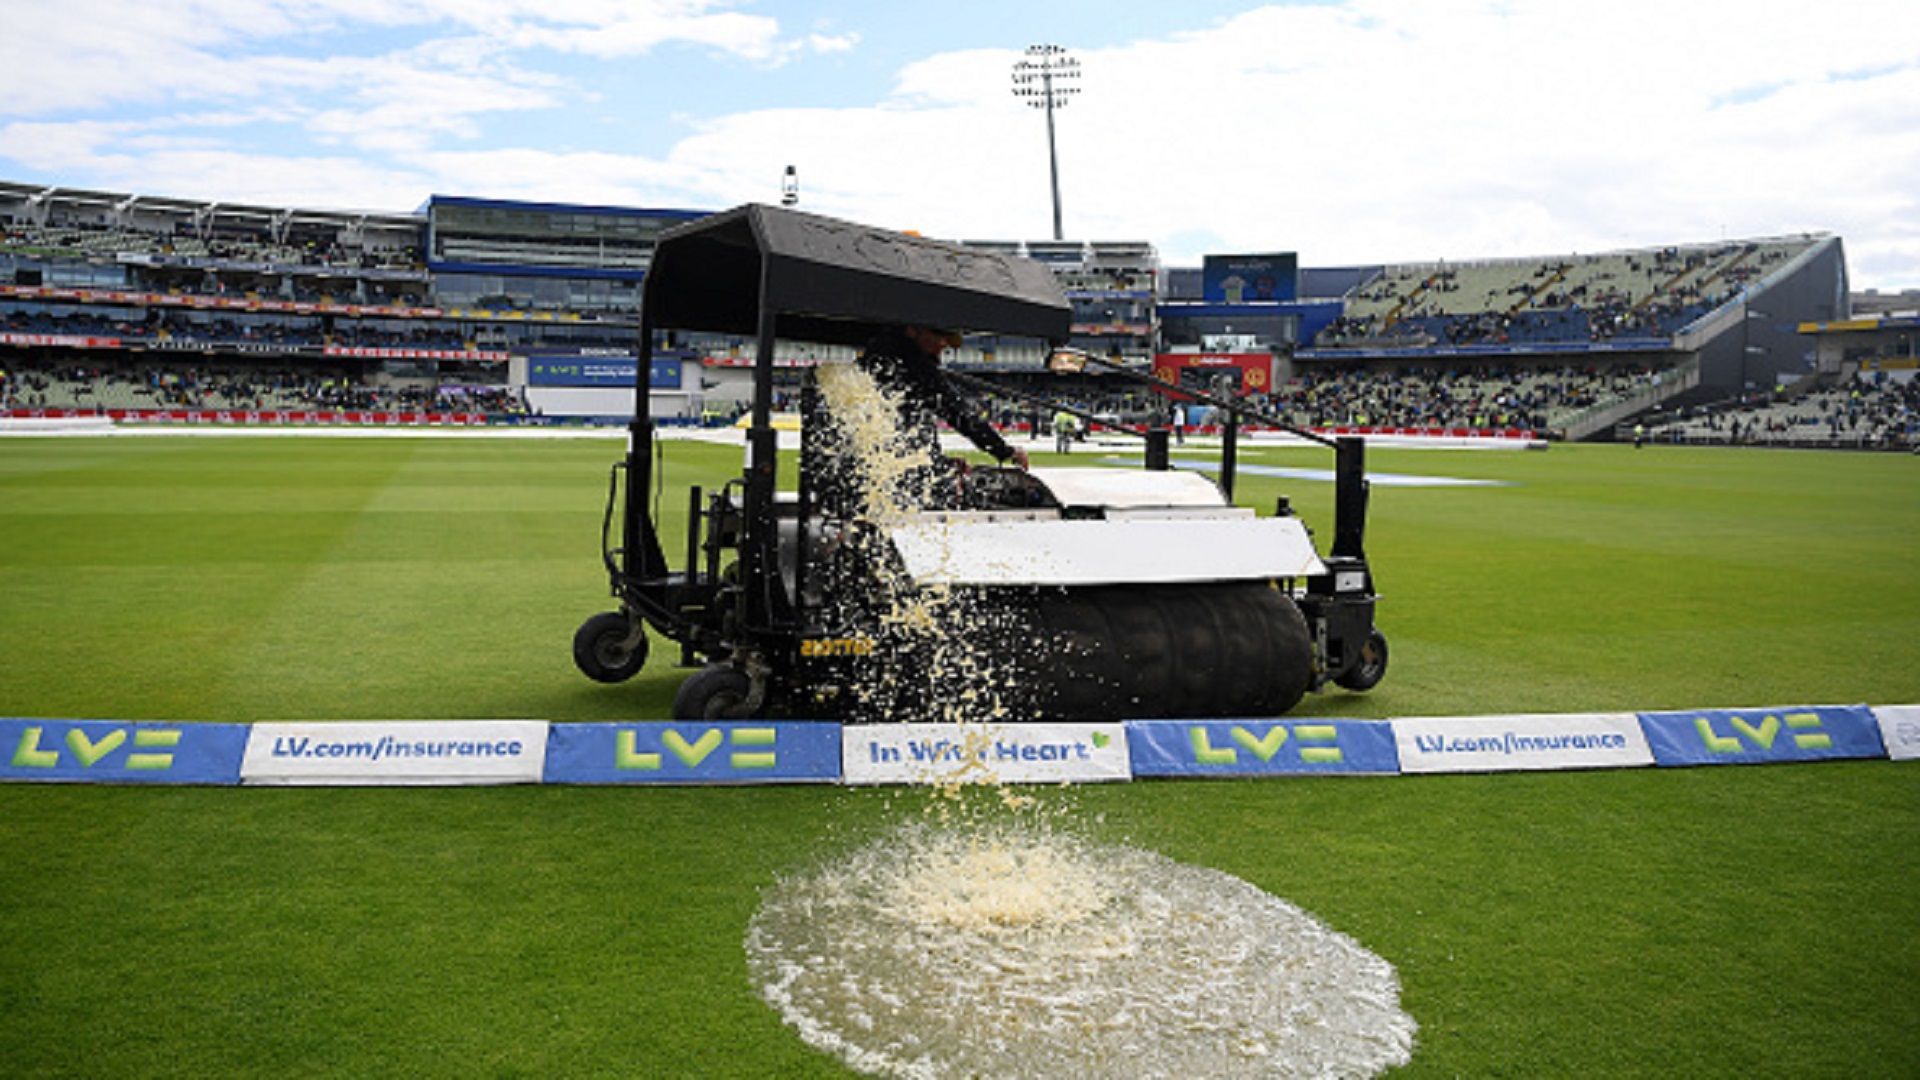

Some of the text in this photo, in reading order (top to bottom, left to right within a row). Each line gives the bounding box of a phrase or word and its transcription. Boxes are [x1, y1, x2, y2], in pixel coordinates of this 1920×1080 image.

[272, 736, 523, 760] LV.com/insurance
[869, 742, 899, 762] In
[995, 741, 1090, 761] Heart
[1415, 731, 1626, 754] LV.com/insurance
